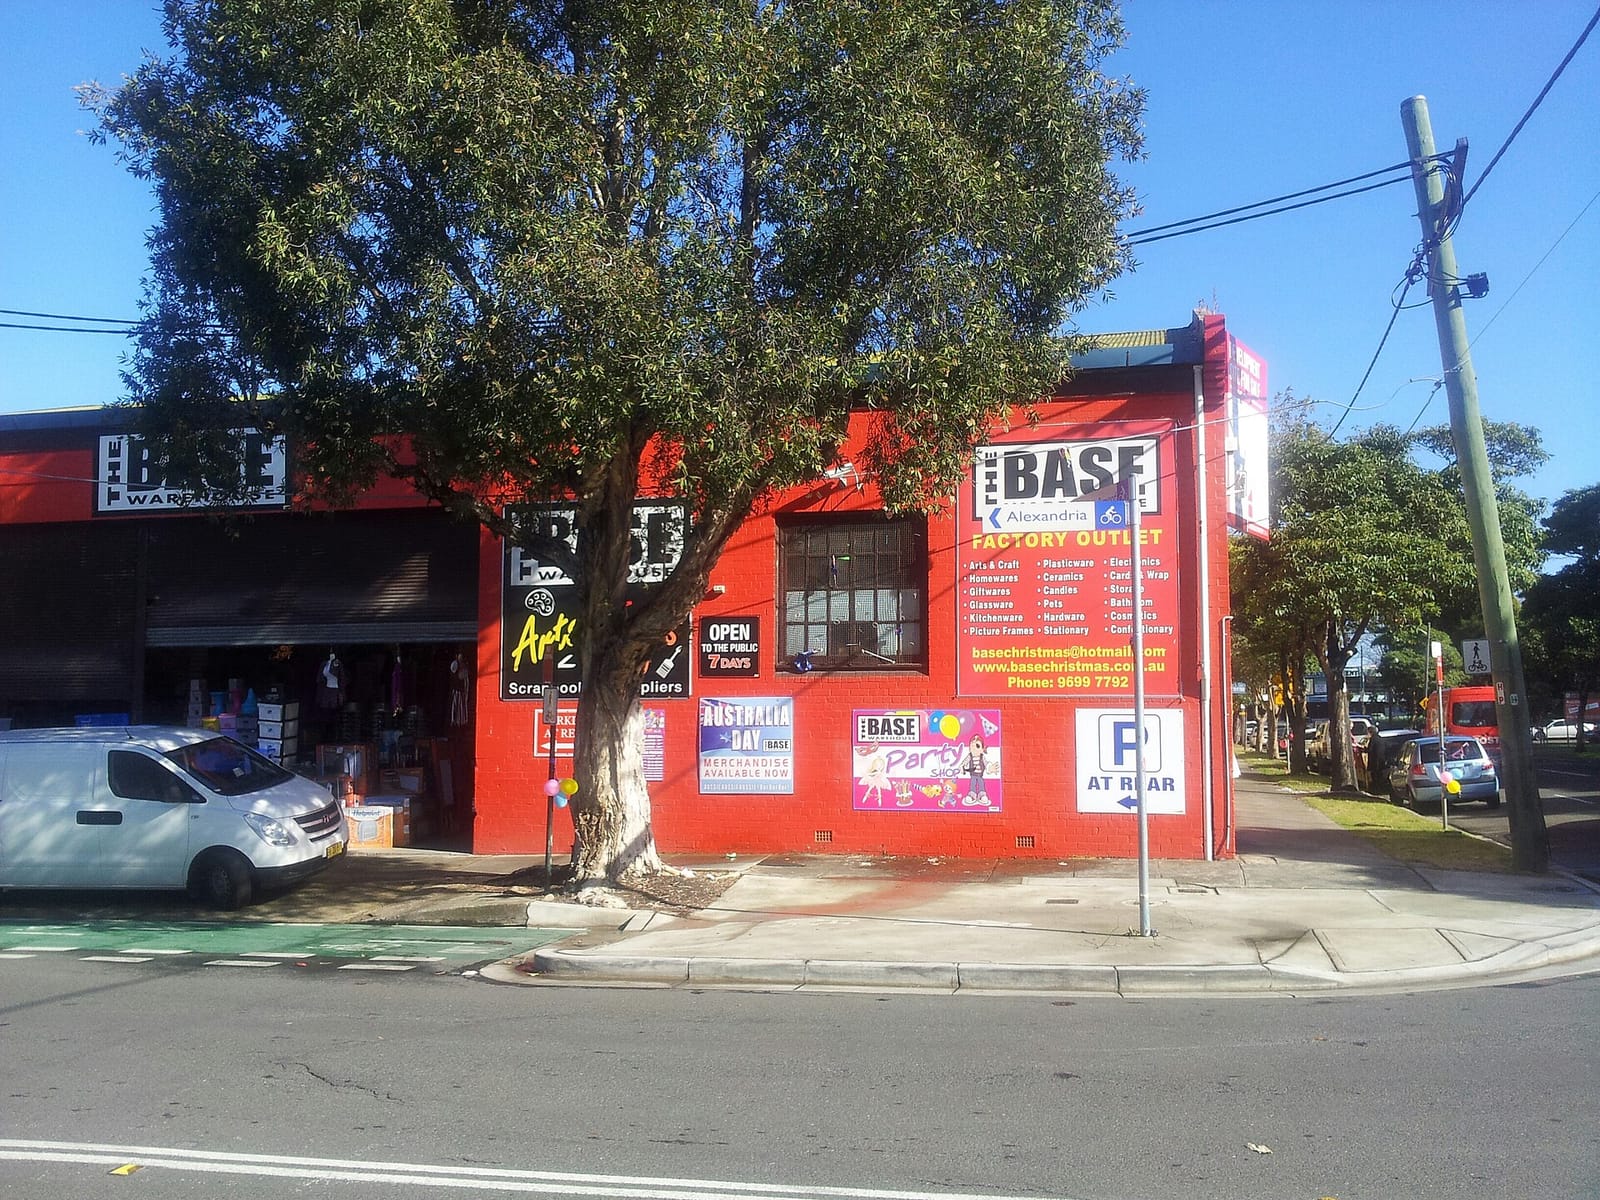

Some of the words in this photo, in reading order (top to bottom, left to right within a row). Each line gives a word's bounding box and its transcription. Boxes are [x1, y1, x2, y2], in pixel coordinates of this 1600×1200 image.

[107, 441, 121, 506] THE
[1004, 446, 1144, 499] BASE
[985, 451, 997, 505] THE
[1007, 510, 1088, 522] Alexandria
[972, 531, 1070, 549] FACTORY
[1076, 529, 1162, 546] OUTLET
[969, 561, 987, 570] Arts
[989, 561, 995, 569] &
[998, 560, 1019, 569] Craft
[1043, 559, 1094, 568] Plasticware
[1110, 557, 1161, 567] Elecnics
[969, 574, 1018, 583] Homewares
[1043, 573, 1084, 582] Ceramics
[1147, 570, 1169, 580] Wrap
[969, 587, 1011, 597] Giftwares
[1043, 586, 1078, 595] Candles
[969, 600, 1014, 610] Glassware
[1110, 598, 1153, 607] Bathom
[969, 613, 1023, 623] Kitchenware
[1043, 612, 1085, 622] Hardware
[1110, 611, 1157, 621] Cosmtics
[709, 624, 750, 641] OPEN
[969, 626, 1000, 636] Picture
[1002, 626, 1034, 636] Frames
[1043, 625, 1089, 635] Stationary
[1110, 625, 1173, 636] Conftionary
[701, 644, 712, 652] TO
[713, 644, 728, 652] THE
[730, 643, 758, 652] PUBLIC
[972, 645, 1166, 658] basechristmas@hotmail.om
[708, 654, 719, 668] 7
[720, 658, 751, 668] DAYS
[1008, 677, 1054, 688] Phone:
[1057, 676, 1091, 687] 9699
[1095, 676, 1129, 687] 7792
[703, 705, 790, 726] AUSTRALIA
[867, 718, 915, 736] BASE
[732, 730, 760, 750] DAY
[768, 741, 789, 749] BASE
[1113, 721, 1149, 765] P
[704, 758, 789, 768] MERCHANDISE
[885, 743, 965, 773] Party
[704, 769, 761, 778] AVAILABLE
[764, 769, 789, 778] NOW
[930, 768, 960, 777] SHOP
[1088, 776, 1113, 790] AT
[1121, 777, 1175, 791] RAR
